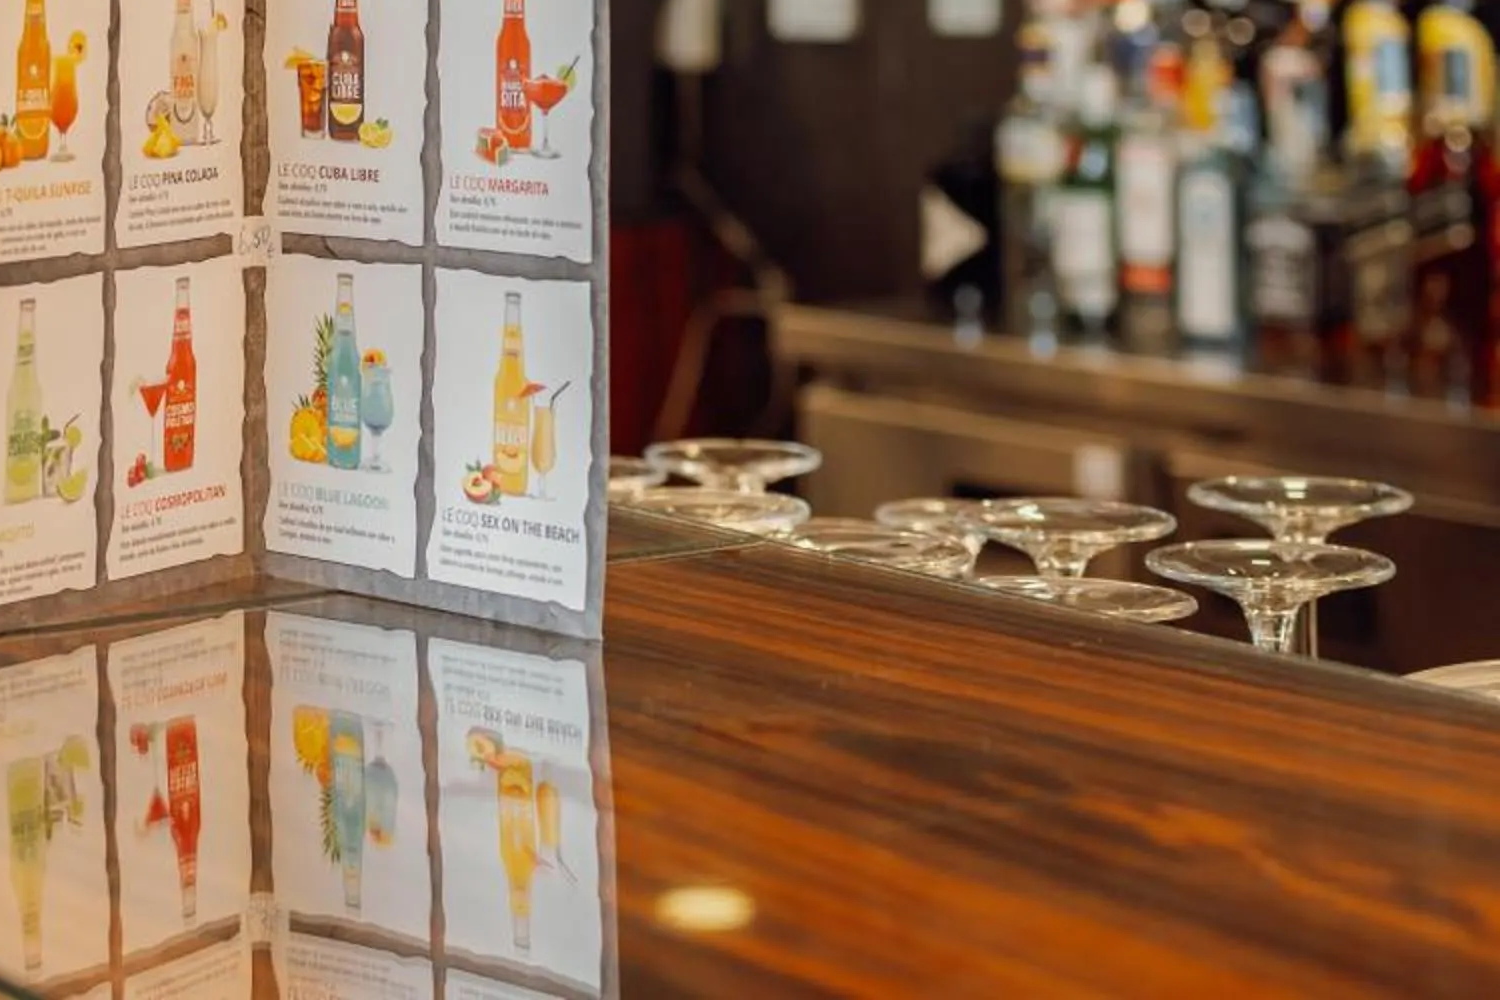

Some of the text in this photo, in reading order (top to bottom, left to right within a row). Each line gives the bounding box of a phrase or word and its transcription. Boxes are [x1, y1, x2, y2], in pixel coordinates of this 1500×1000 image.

[162, 170, 185, 186] PINA
[185, 166, 219, 183] COLADA
[277, 163, 290, 178] LE
[318, 165, 348, 181] CUBA
[350, 167, 381, 183] LIBRE
[487, 177, 550, 197] MARGARITA
[154, 484, 227, 513] COSMOPOLITAN
[480, 512, 500, 530] SEX
[501, 516, 520, 534] ON
[521, 519, 543, 538] THE
[544, 523, 581, 544] BEACH
